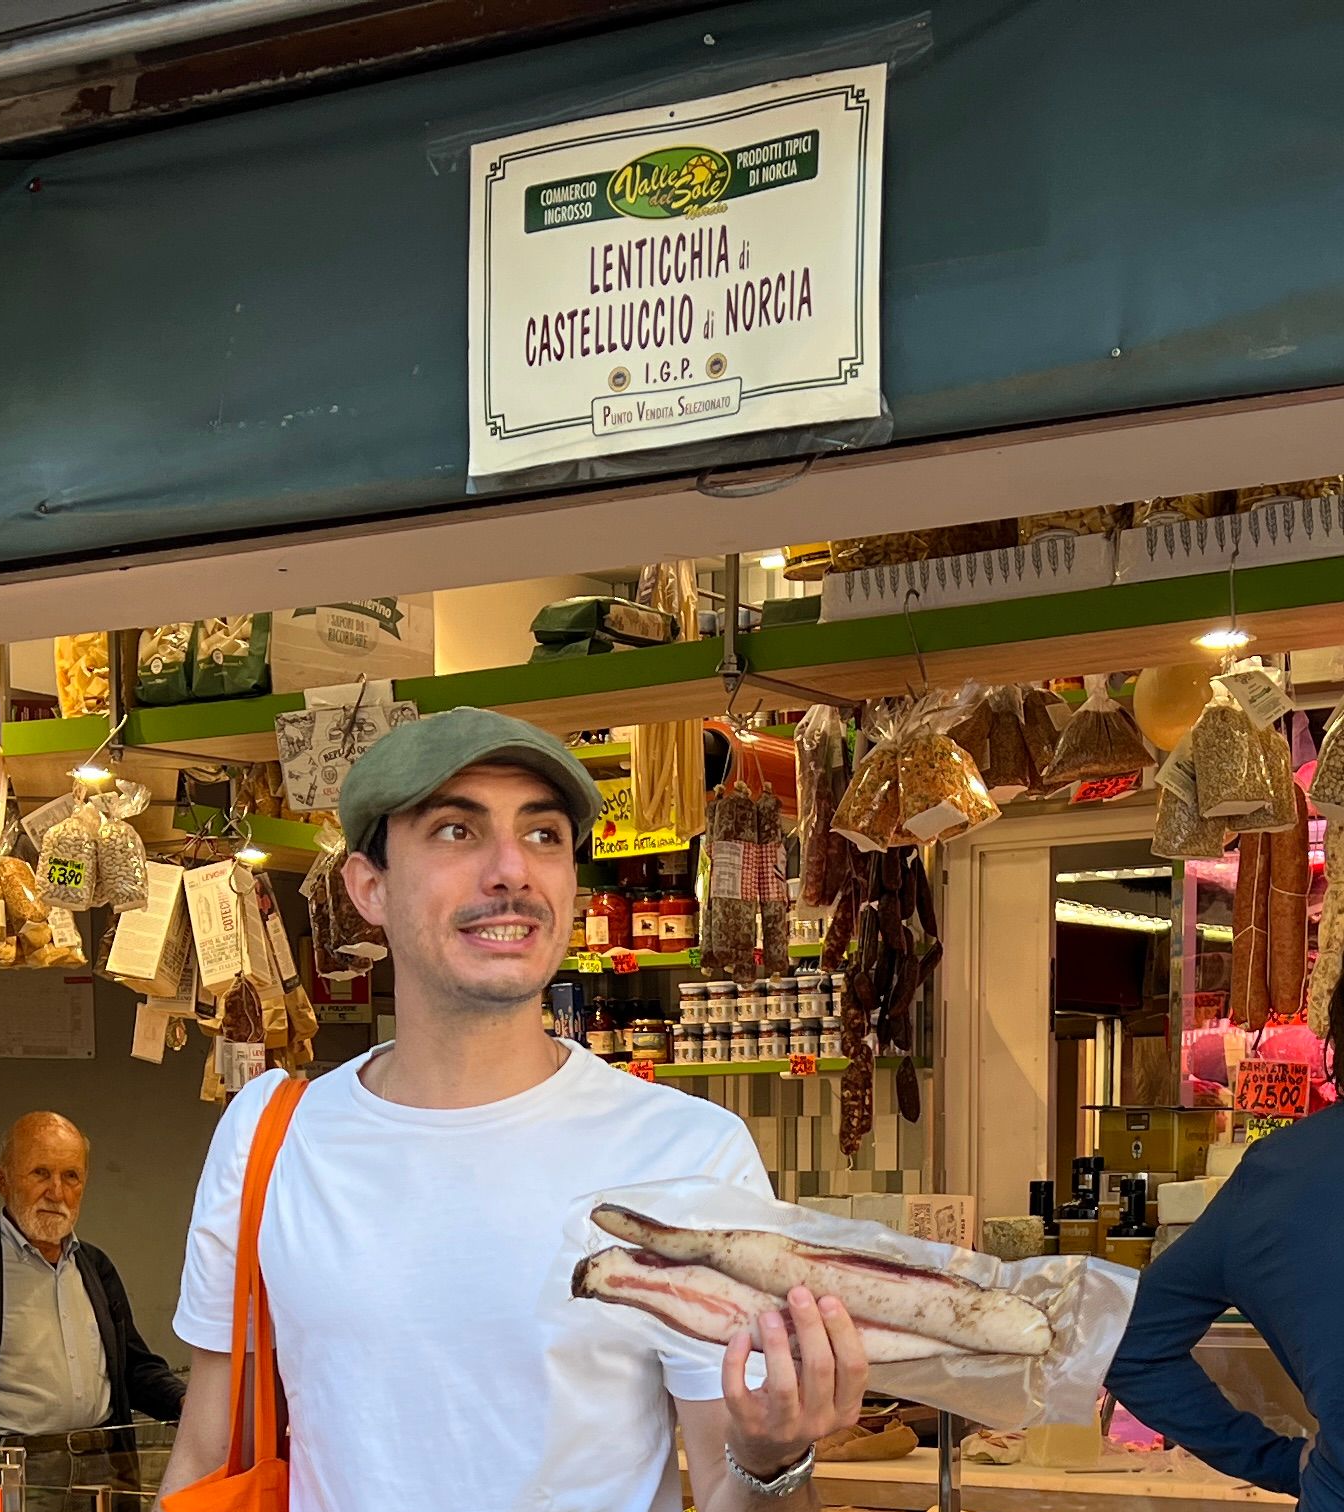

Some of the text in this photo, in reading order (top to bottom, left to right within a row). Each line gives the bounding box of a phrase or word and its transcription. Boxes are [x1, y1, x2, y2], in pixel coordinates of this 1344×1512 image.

[736, 135, 812, 170] PRODOTTI TIPICI
[614, 163, 680, 204] Valle
[670, 174, 721, 209] Sole
[748, 160, 798, 188] DI NORCIA
[540, 181, 598, 207] COMMERCIO
[543, 203, 593, 226] INGROSSO
[589, 224, 751, 295] LENTICCHIA di
[525, 266, 813, 367] CASTELLUCCIO di NORCIA
[644, 356, 694, 385] I.G.P.
